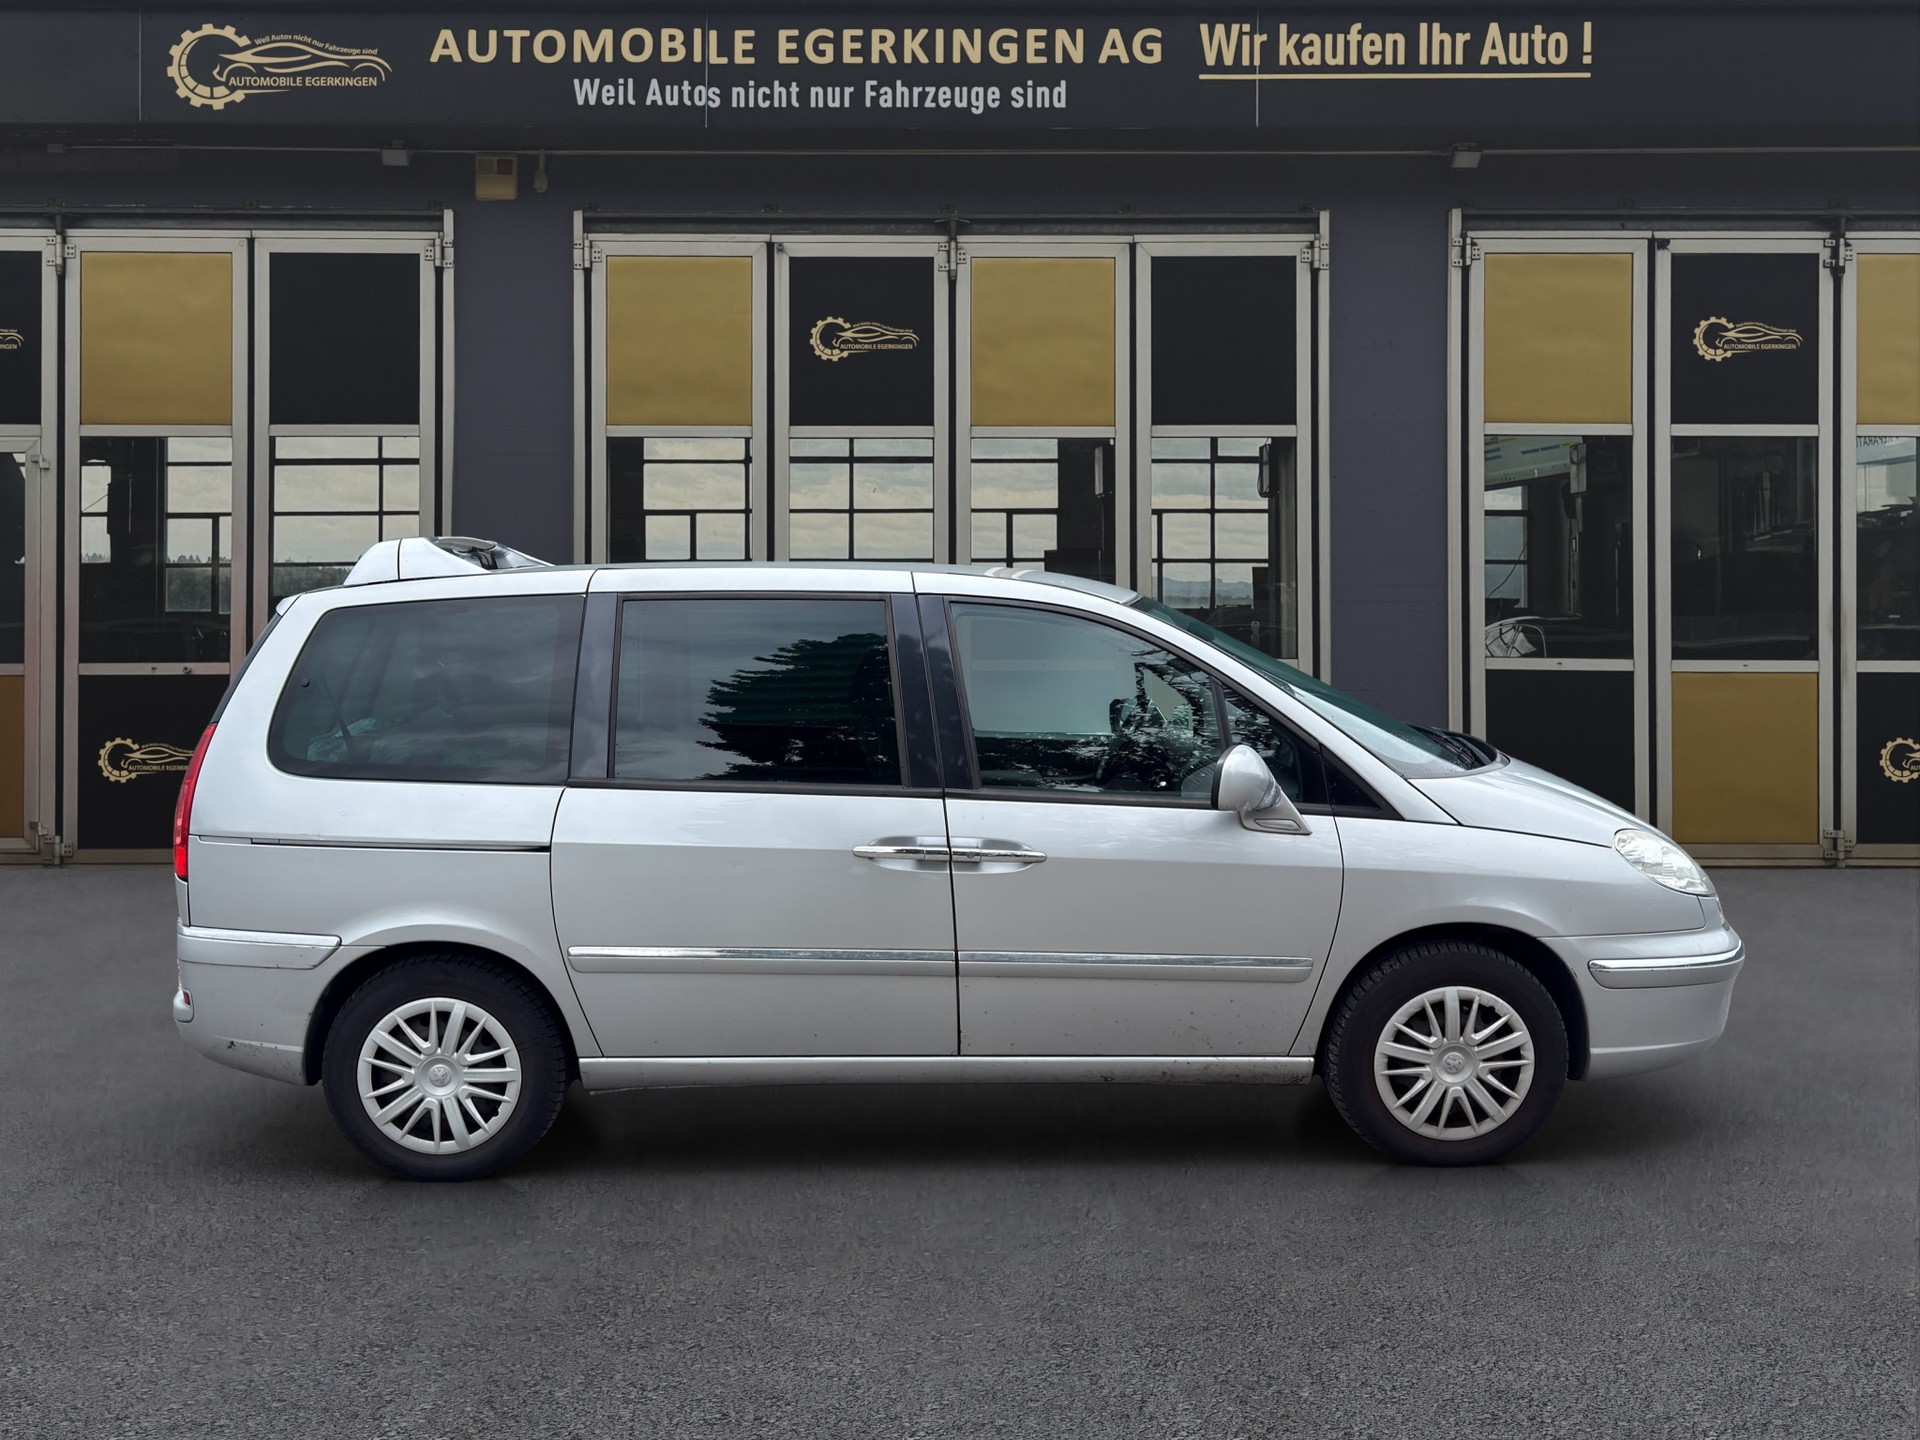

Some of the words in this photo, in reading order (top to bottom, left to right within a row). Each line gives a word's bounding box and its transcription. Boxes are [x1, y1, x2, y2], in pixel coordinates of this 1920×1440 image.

[254, 36, 270, 45] Weil
[293, 34, 312, 44] nicht
[311, 40, 325, 48] nur
[324, 43, 361, 55] Fahrzeuge
[430, 28, 755, 64] AUTOMOBILE
[778, 28, 1083, 64] EGERKINGEN
[1099, 28, 1161, 64] AG
[1200, 23, 1267, 65] Wir
[1279, 23, 1405, 65] kaufen
[1420, 23, 1470, 65] Ihr
[1480, 23, 1568, 65] Auto
[1583, 22, 1592, 64] !
[229, 76, 302, 87] AUTOMOBILE
[305, 76, 377, 87] EGERKINGEN
[574, 78, 635, 105] Weil
[645, 78, 720, 108] Autos
[732, 80, 799, 108] nicht
[811, 87, 854, 107] nur
[866, 80, 1000, 114] Fahrzeuge
[1011, 80, 1066, 108] sind
